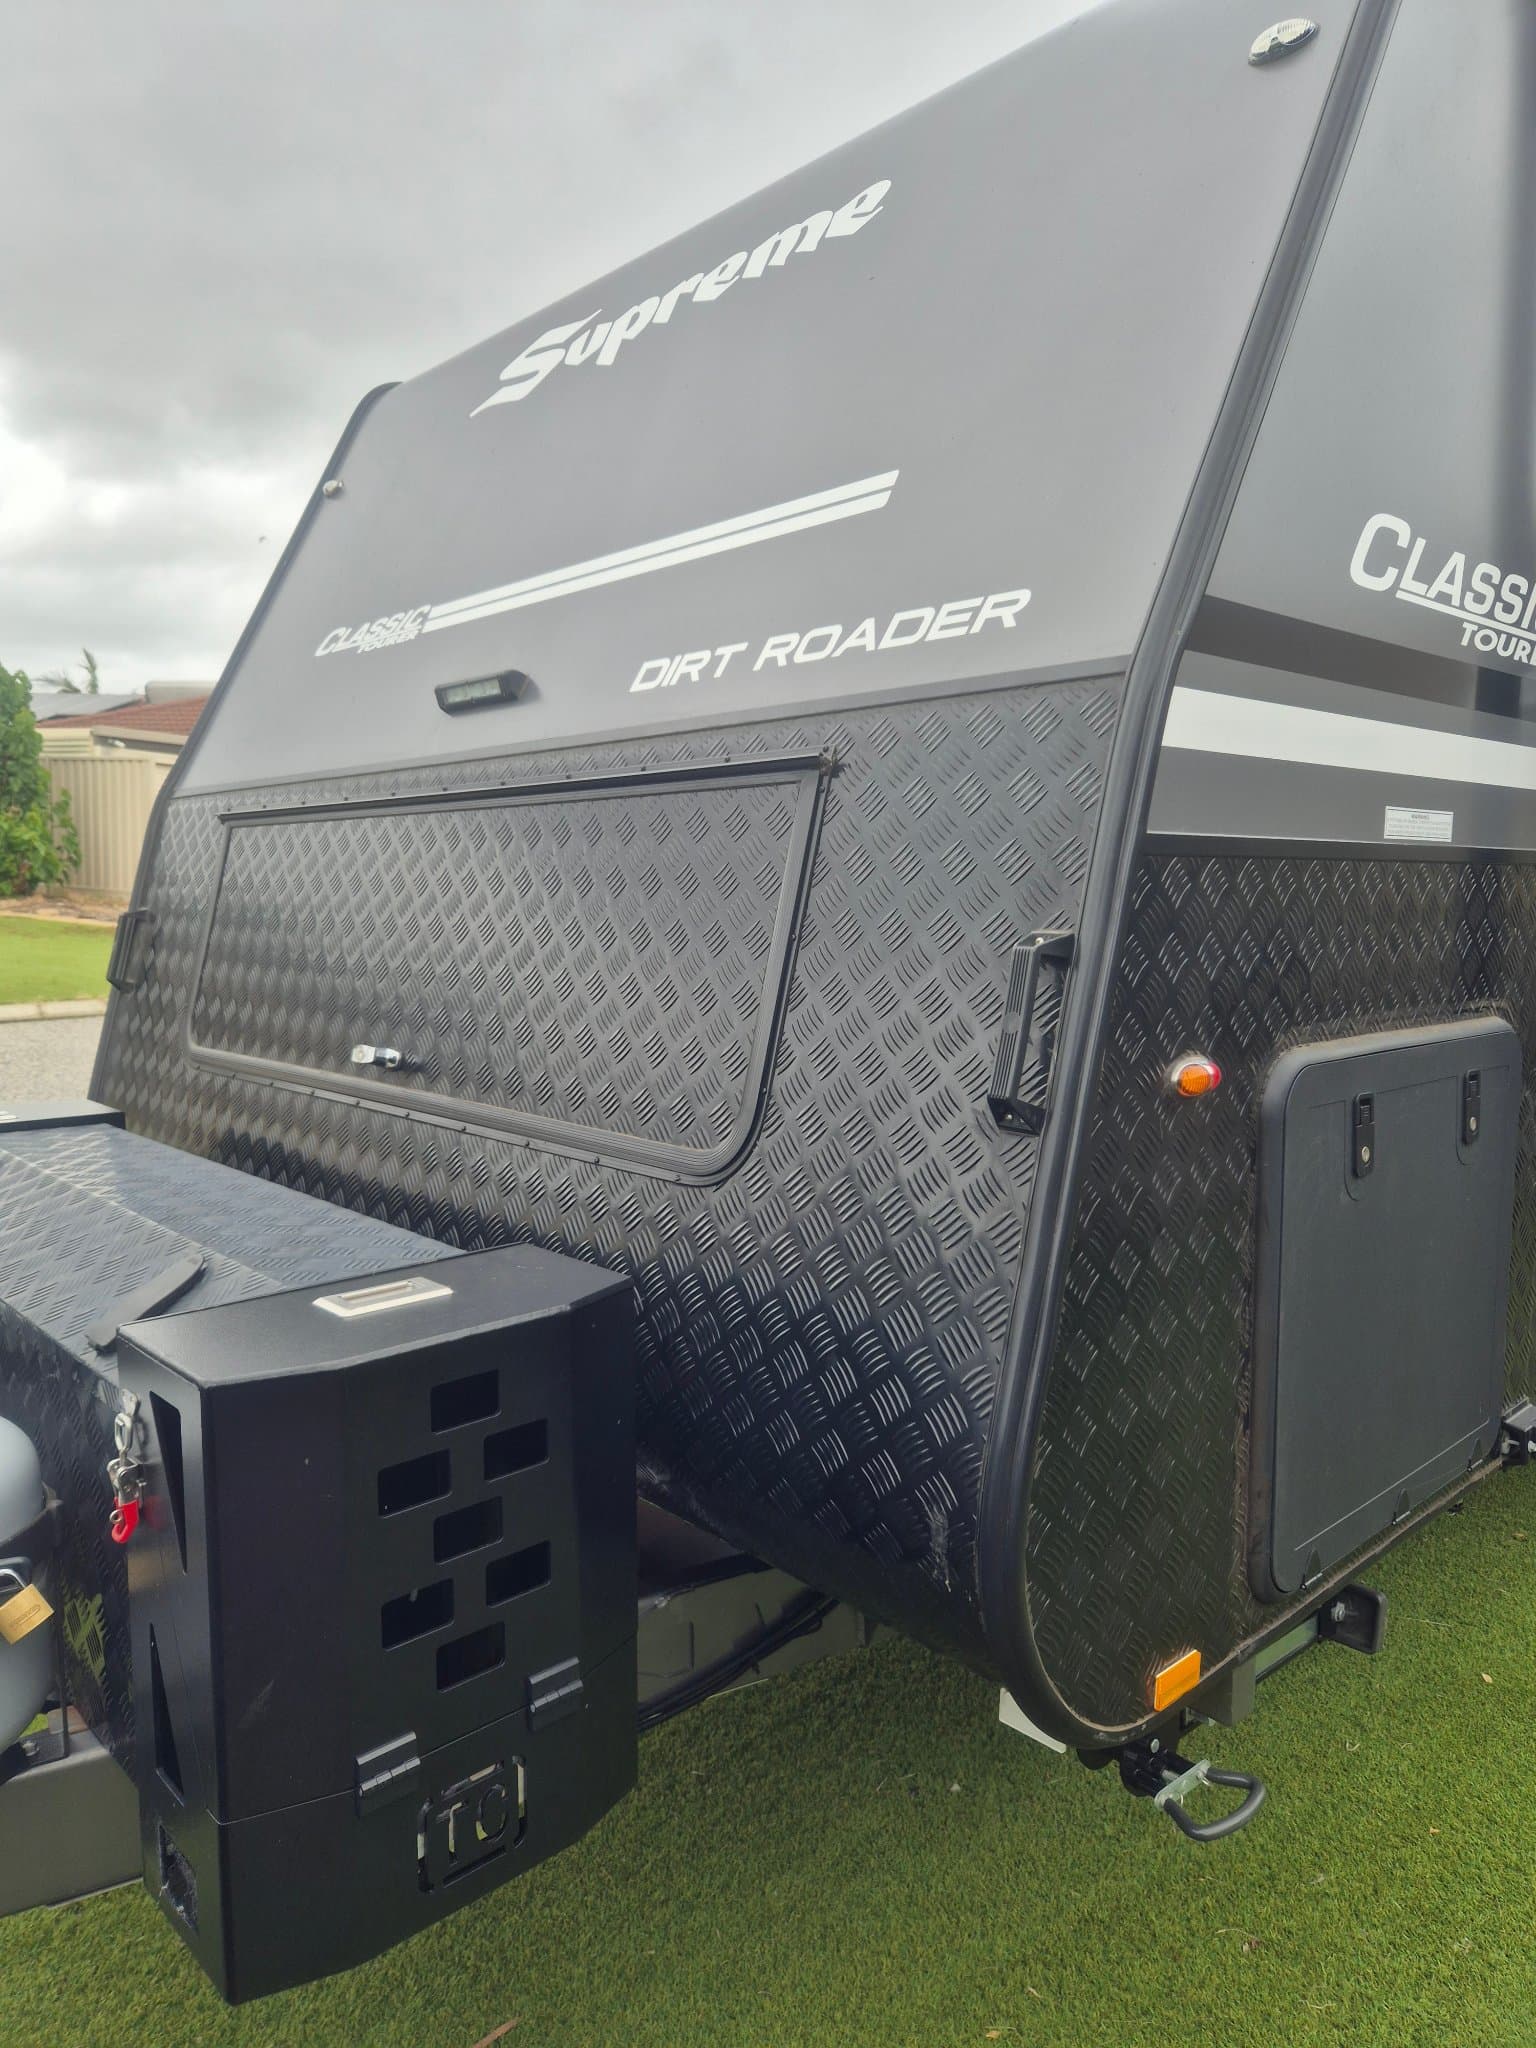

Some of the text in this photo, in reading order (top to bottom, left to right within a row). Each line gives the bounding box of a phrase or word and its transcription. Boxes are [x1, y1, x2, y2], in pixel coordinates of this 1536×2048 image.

[469, 179, 892, 419] Supreme
[1350, 512, 1536, 630] CLASSI
[314, 604, 431, 657] CLASSIC
[629, 588, 1032, 694] DIRT ROADER
